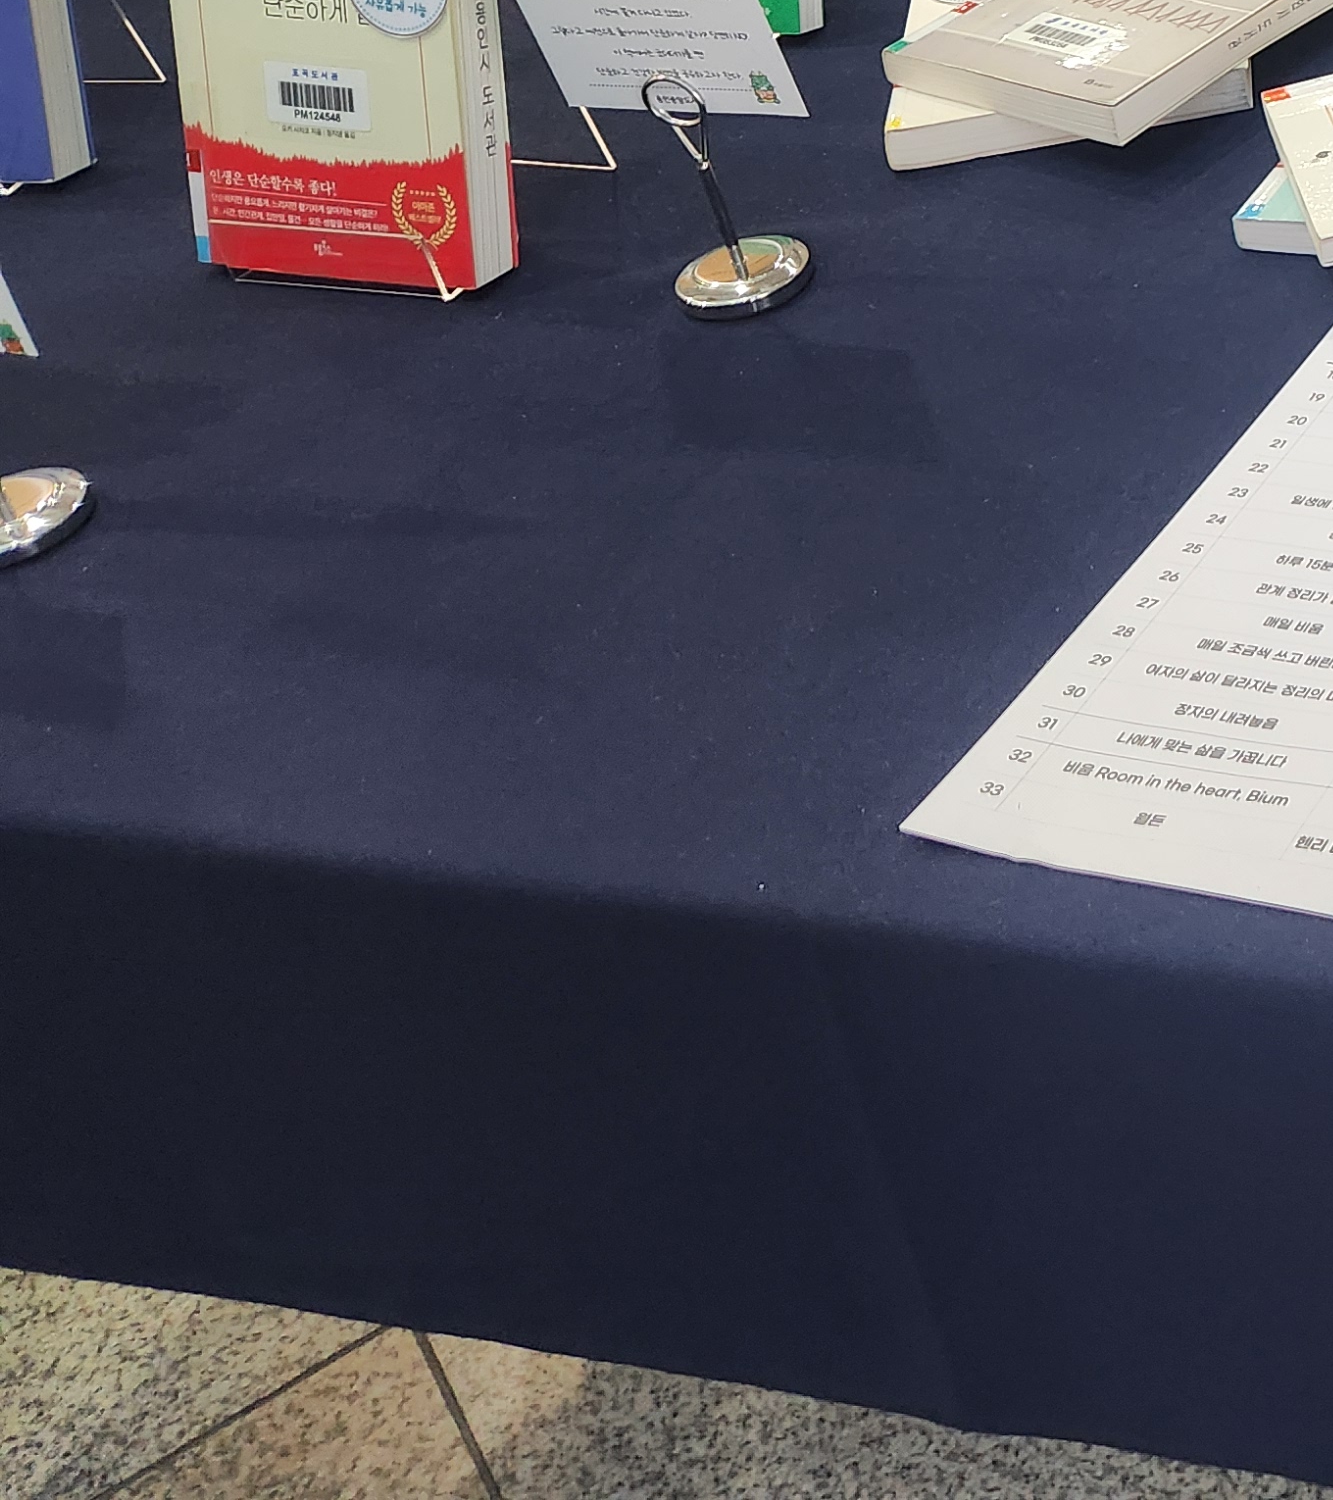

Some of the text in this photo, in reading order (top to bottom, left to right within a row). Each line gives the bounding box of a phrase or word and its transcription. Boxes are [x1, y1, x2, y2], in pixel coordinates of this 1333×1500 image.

[209, 168, 337, 197] 인생은 단순할수록 좋다!
[1062, 758, 1289, 806] 비움 Room in the heart, Bium
